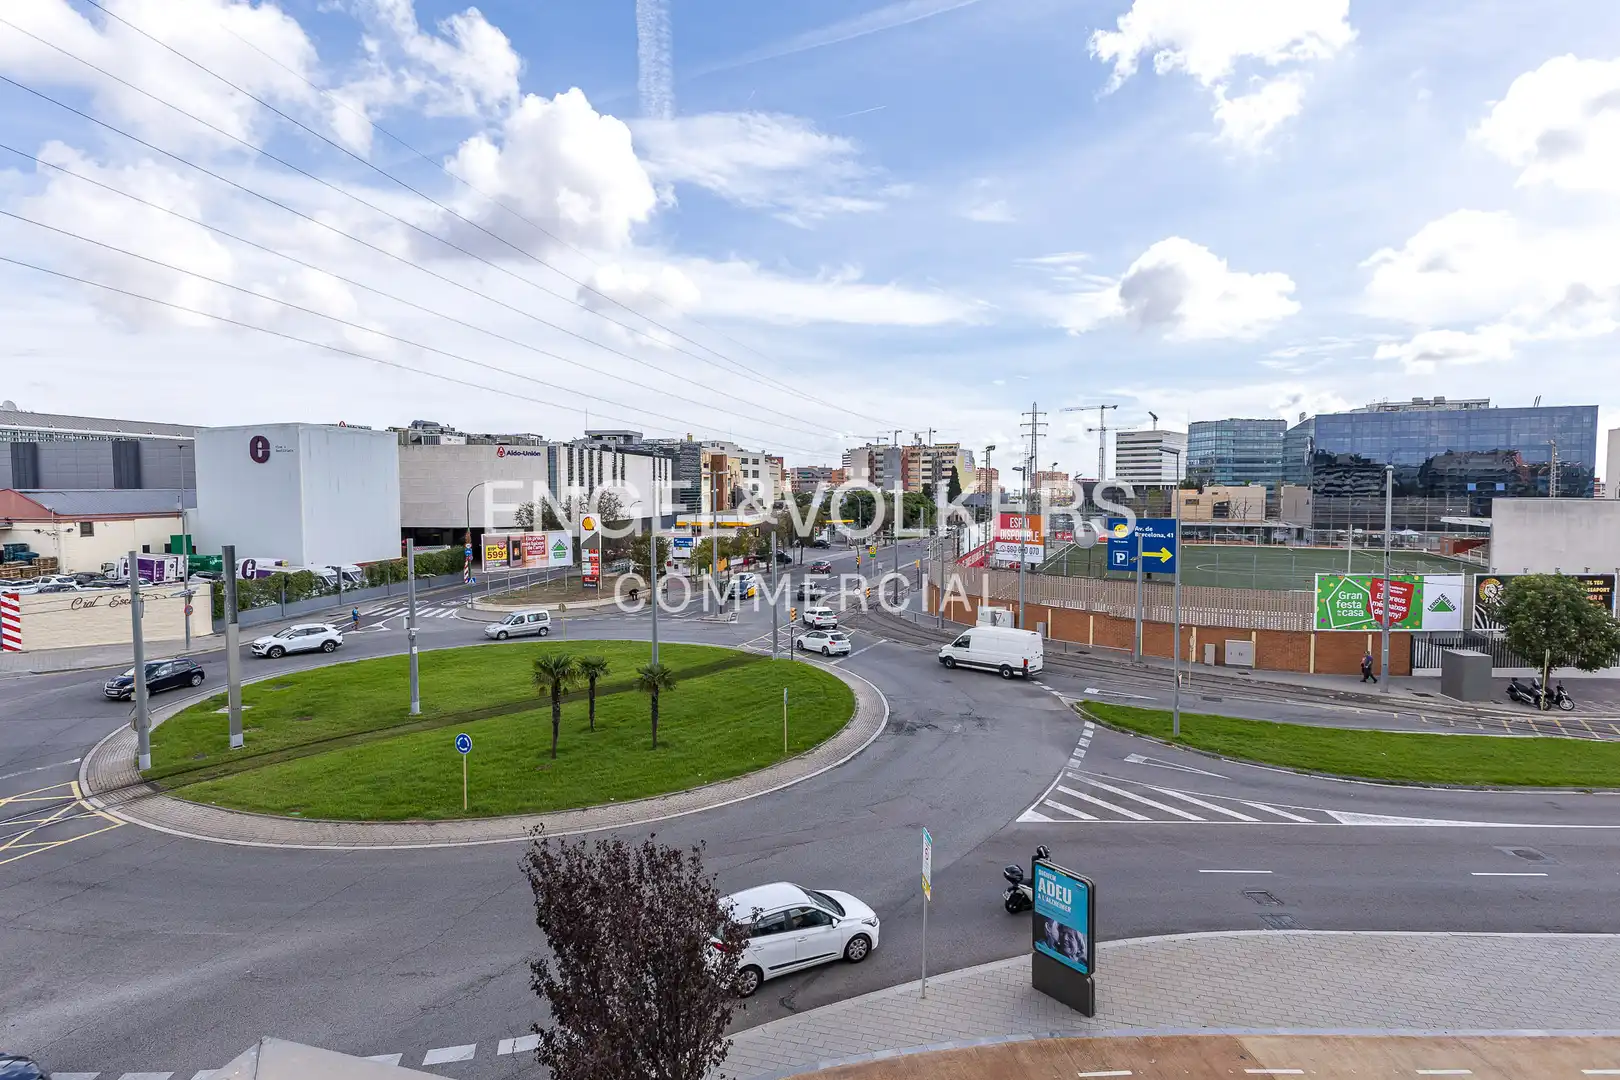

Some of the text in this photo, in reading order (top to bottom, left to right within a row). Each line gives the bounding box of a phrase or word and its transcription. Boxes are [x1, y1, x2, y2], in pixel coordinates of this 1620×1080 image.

[1000, 528, 1040, 542] DISPOBLE
[1338, 591, 1363, 600] Gran
[1439, 593, 1457, 611] MERLIN
[1336, 600, 1362, 609] festa
[1372, 600, 1407, 613] mé aixos
[1341, 609, 1364, 617] casa
[1037, 877, 1072, 905] ADEU
